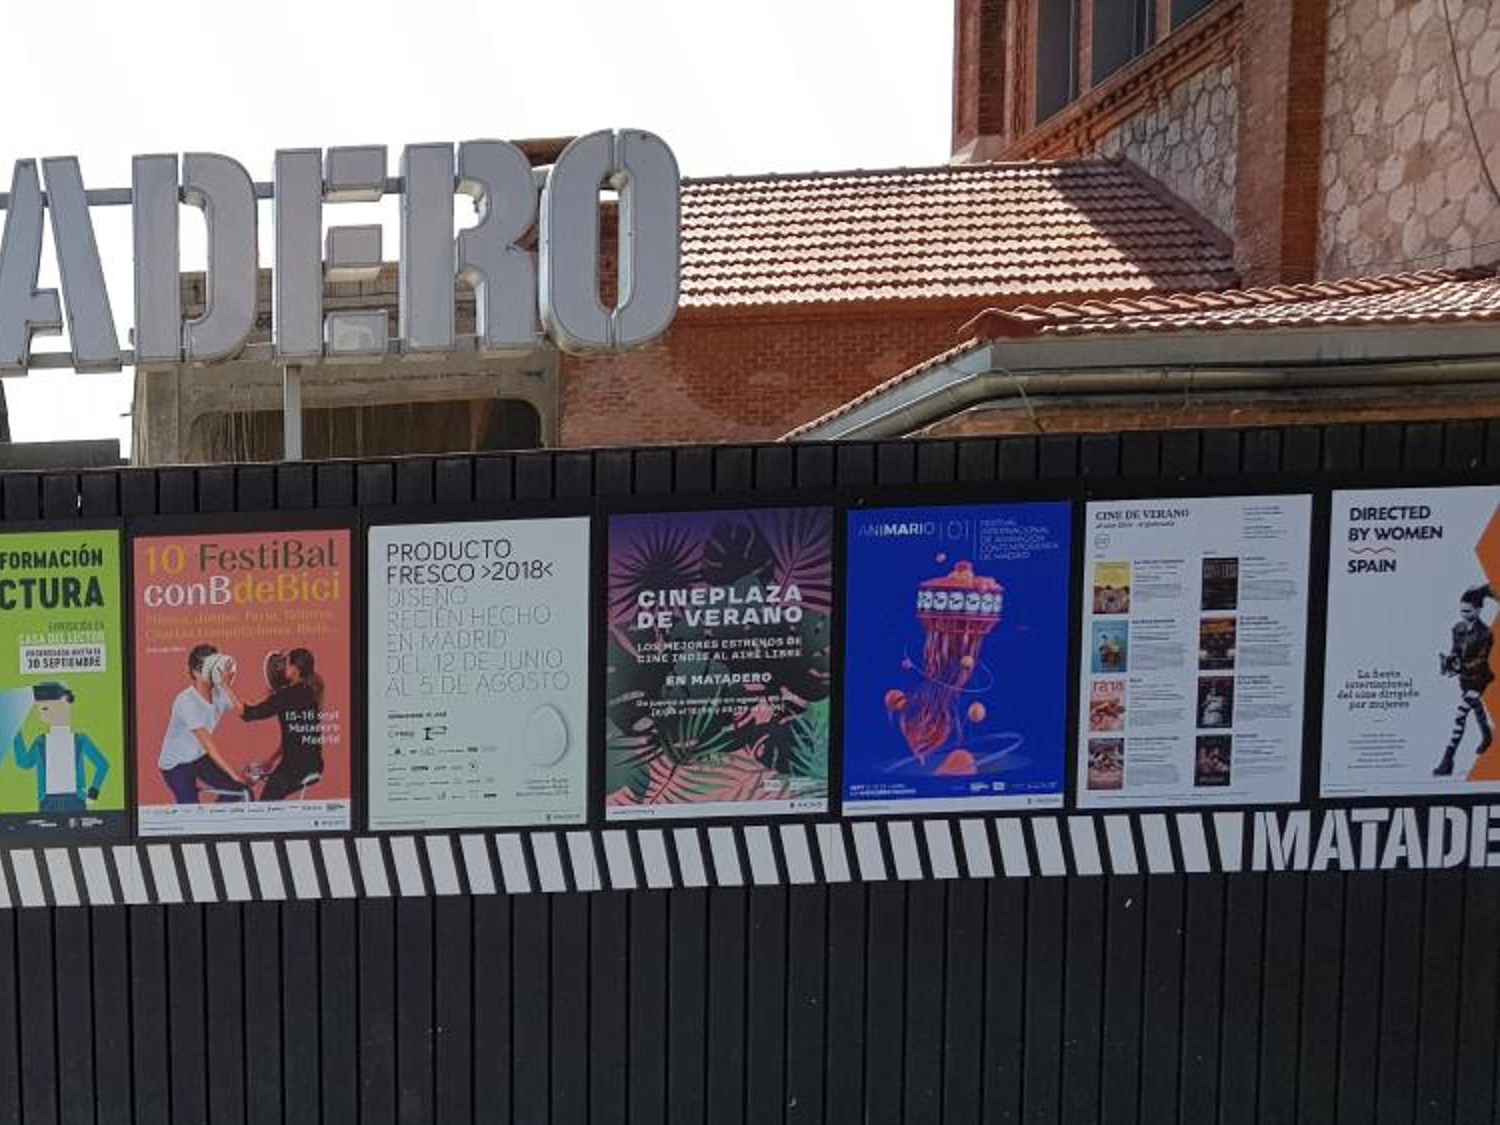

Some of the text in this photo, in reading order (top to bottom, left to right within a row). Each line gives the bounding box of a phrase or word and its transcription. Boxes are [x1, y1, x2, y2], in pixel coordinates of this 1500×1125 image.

[1095, 508, 1189, 521] CINE DE VERANO
[1349, 505, 1431, 521] DIRECTED
[858, 521, 935, 537] ANIMARIO
[1348, 525, 1443, 542] BY WOMEN
[147, 538, 338, 576] 10 FestiBal
[387, 538, 512, 563] PRODUCTO
[387, 562, 475, 584] FRESCO
[1348, 559, 1397, 573] SPAIN
[387, 584, 468, 608] DISEÑO
[637, 584, 803, 608] CINEPLAZA
[471, 604, 551, 627] HECHO
[637, 606, 803, 629] DE VERANO
[387, 628, 508, 653] EN MADRID
[637, 636, 802, 652] LOS MEJORES ESTRENOS DE
[43, 656, 101, 668] SEPTIEMBRE
[387, 648, 563, 675] DEL 12 DE JUNIO
[637, 653, 669, 664] CINE
[713, 651, 729, 661] AL
[731, 649, 762, 660] AIRE
[765, 648, 802, 659] LIBRE
[385, 669, 571, 697] AL 5 DE AGOSTO
[665, 671, 773, 687] EN MATADERO
